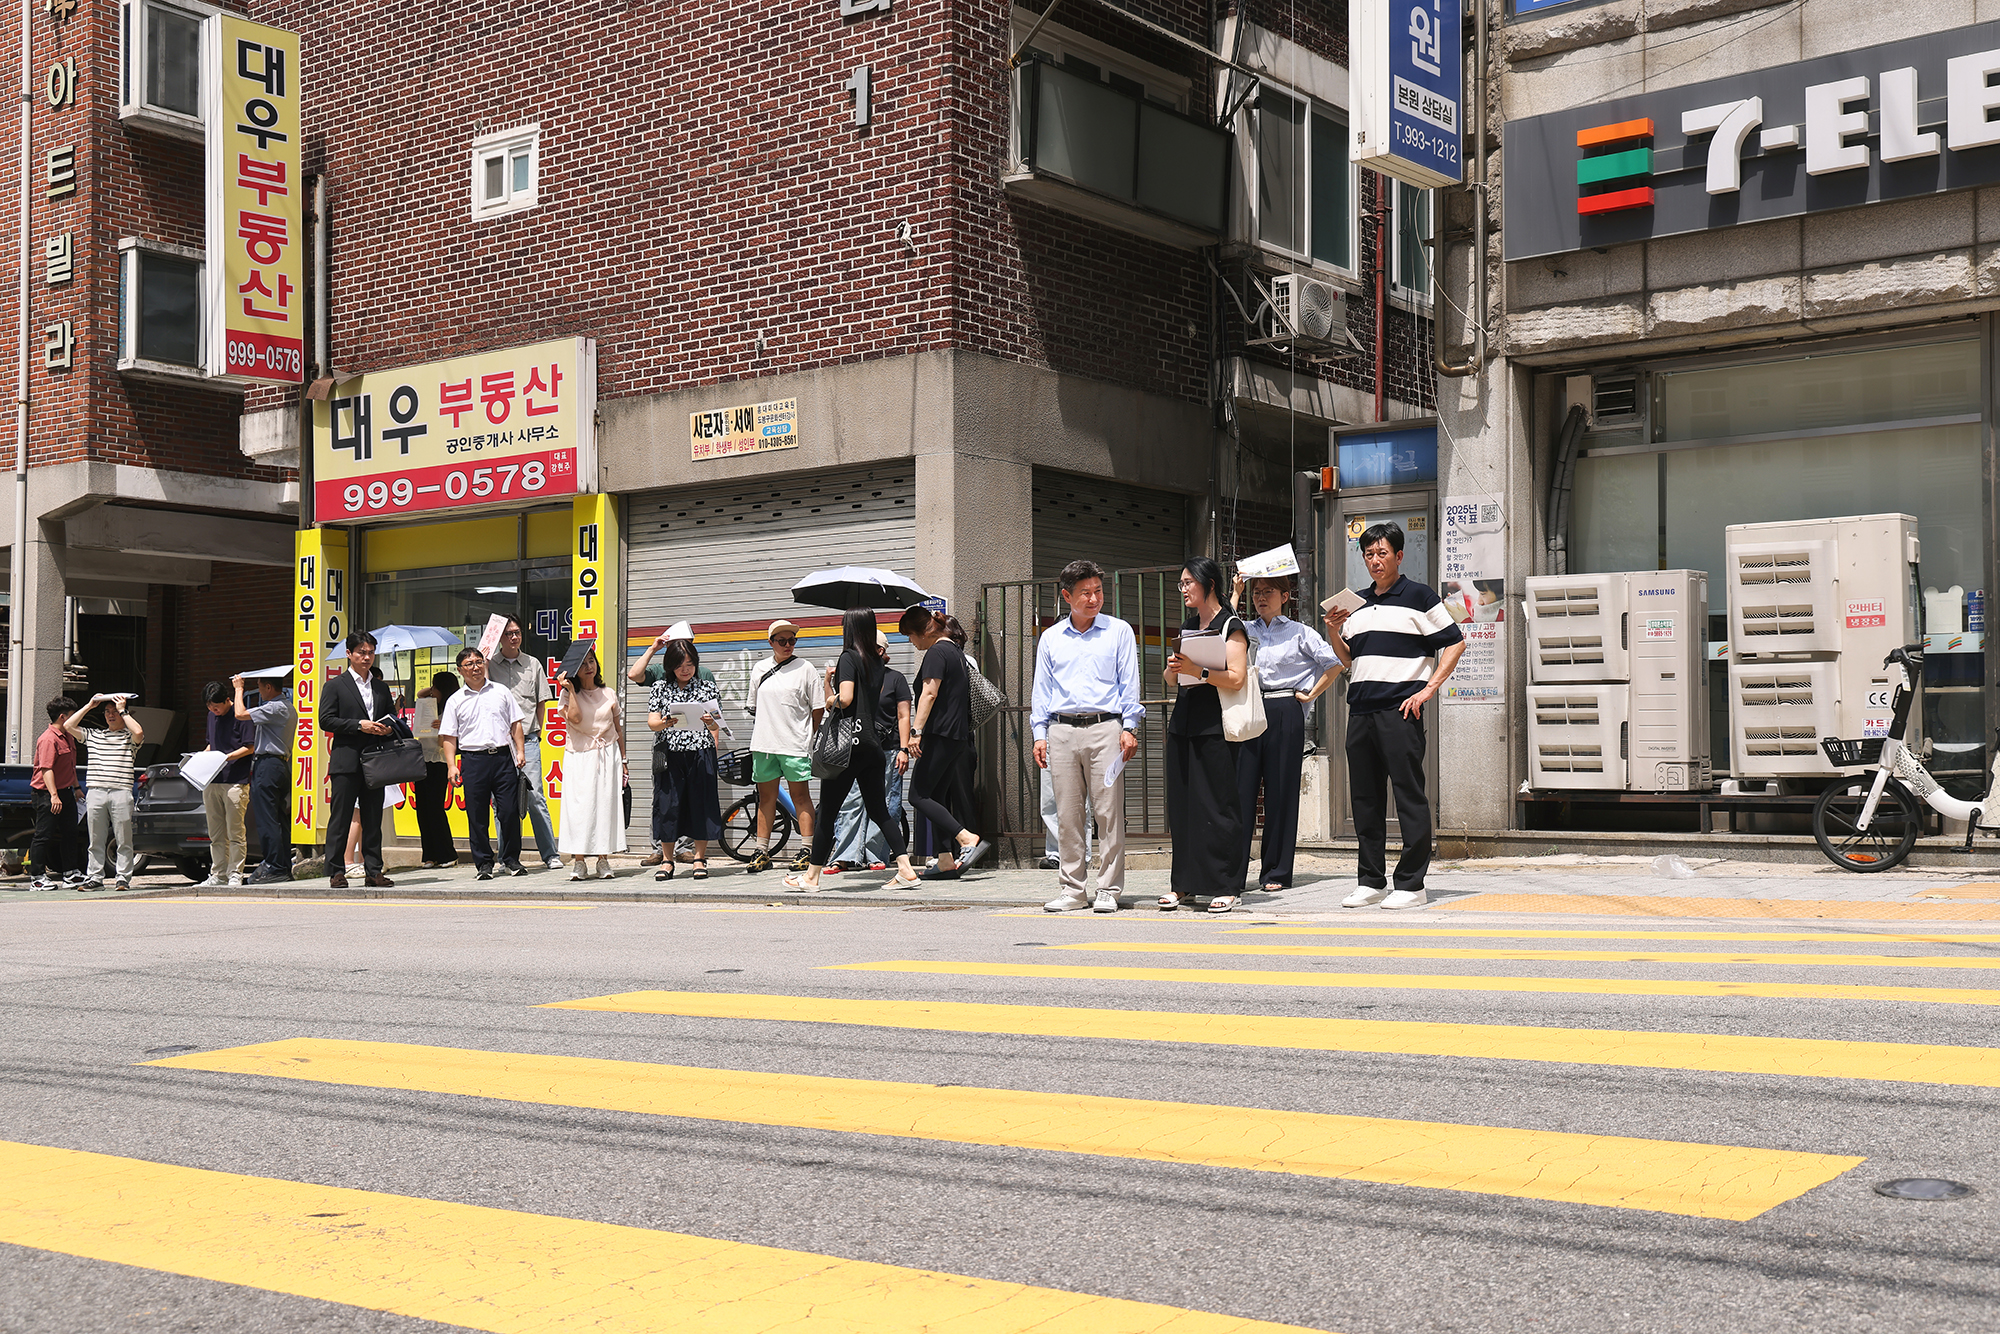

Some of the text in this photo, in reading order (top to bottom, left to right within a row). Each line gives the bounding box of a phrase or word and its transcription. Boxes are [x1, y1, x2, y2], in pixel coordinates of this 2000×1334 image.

[1398, 84, 1453, 126] 본원 상담실
[1394, 121, 1457, 163] T.993-1212
[228, 339, 301, 374] 999-0578
[330, 362, 563, 462] 대우 부동산
[693, 412, 723, 439] 사군자
[446, 423, 559, 454] 공인중개사 사무소
[694, 444, 710, 457] 유치부
[554, 451, 567, 460] 대표
[343, 460, 546, 512] 999-0578
[1446, 503, 1478, 515] 2025년
[1638, 588, 1676, 596] SAMSUNG
[1848, 602, 1882, 613] 인버터
[1850, 617, 1881, 626] 냉장용
